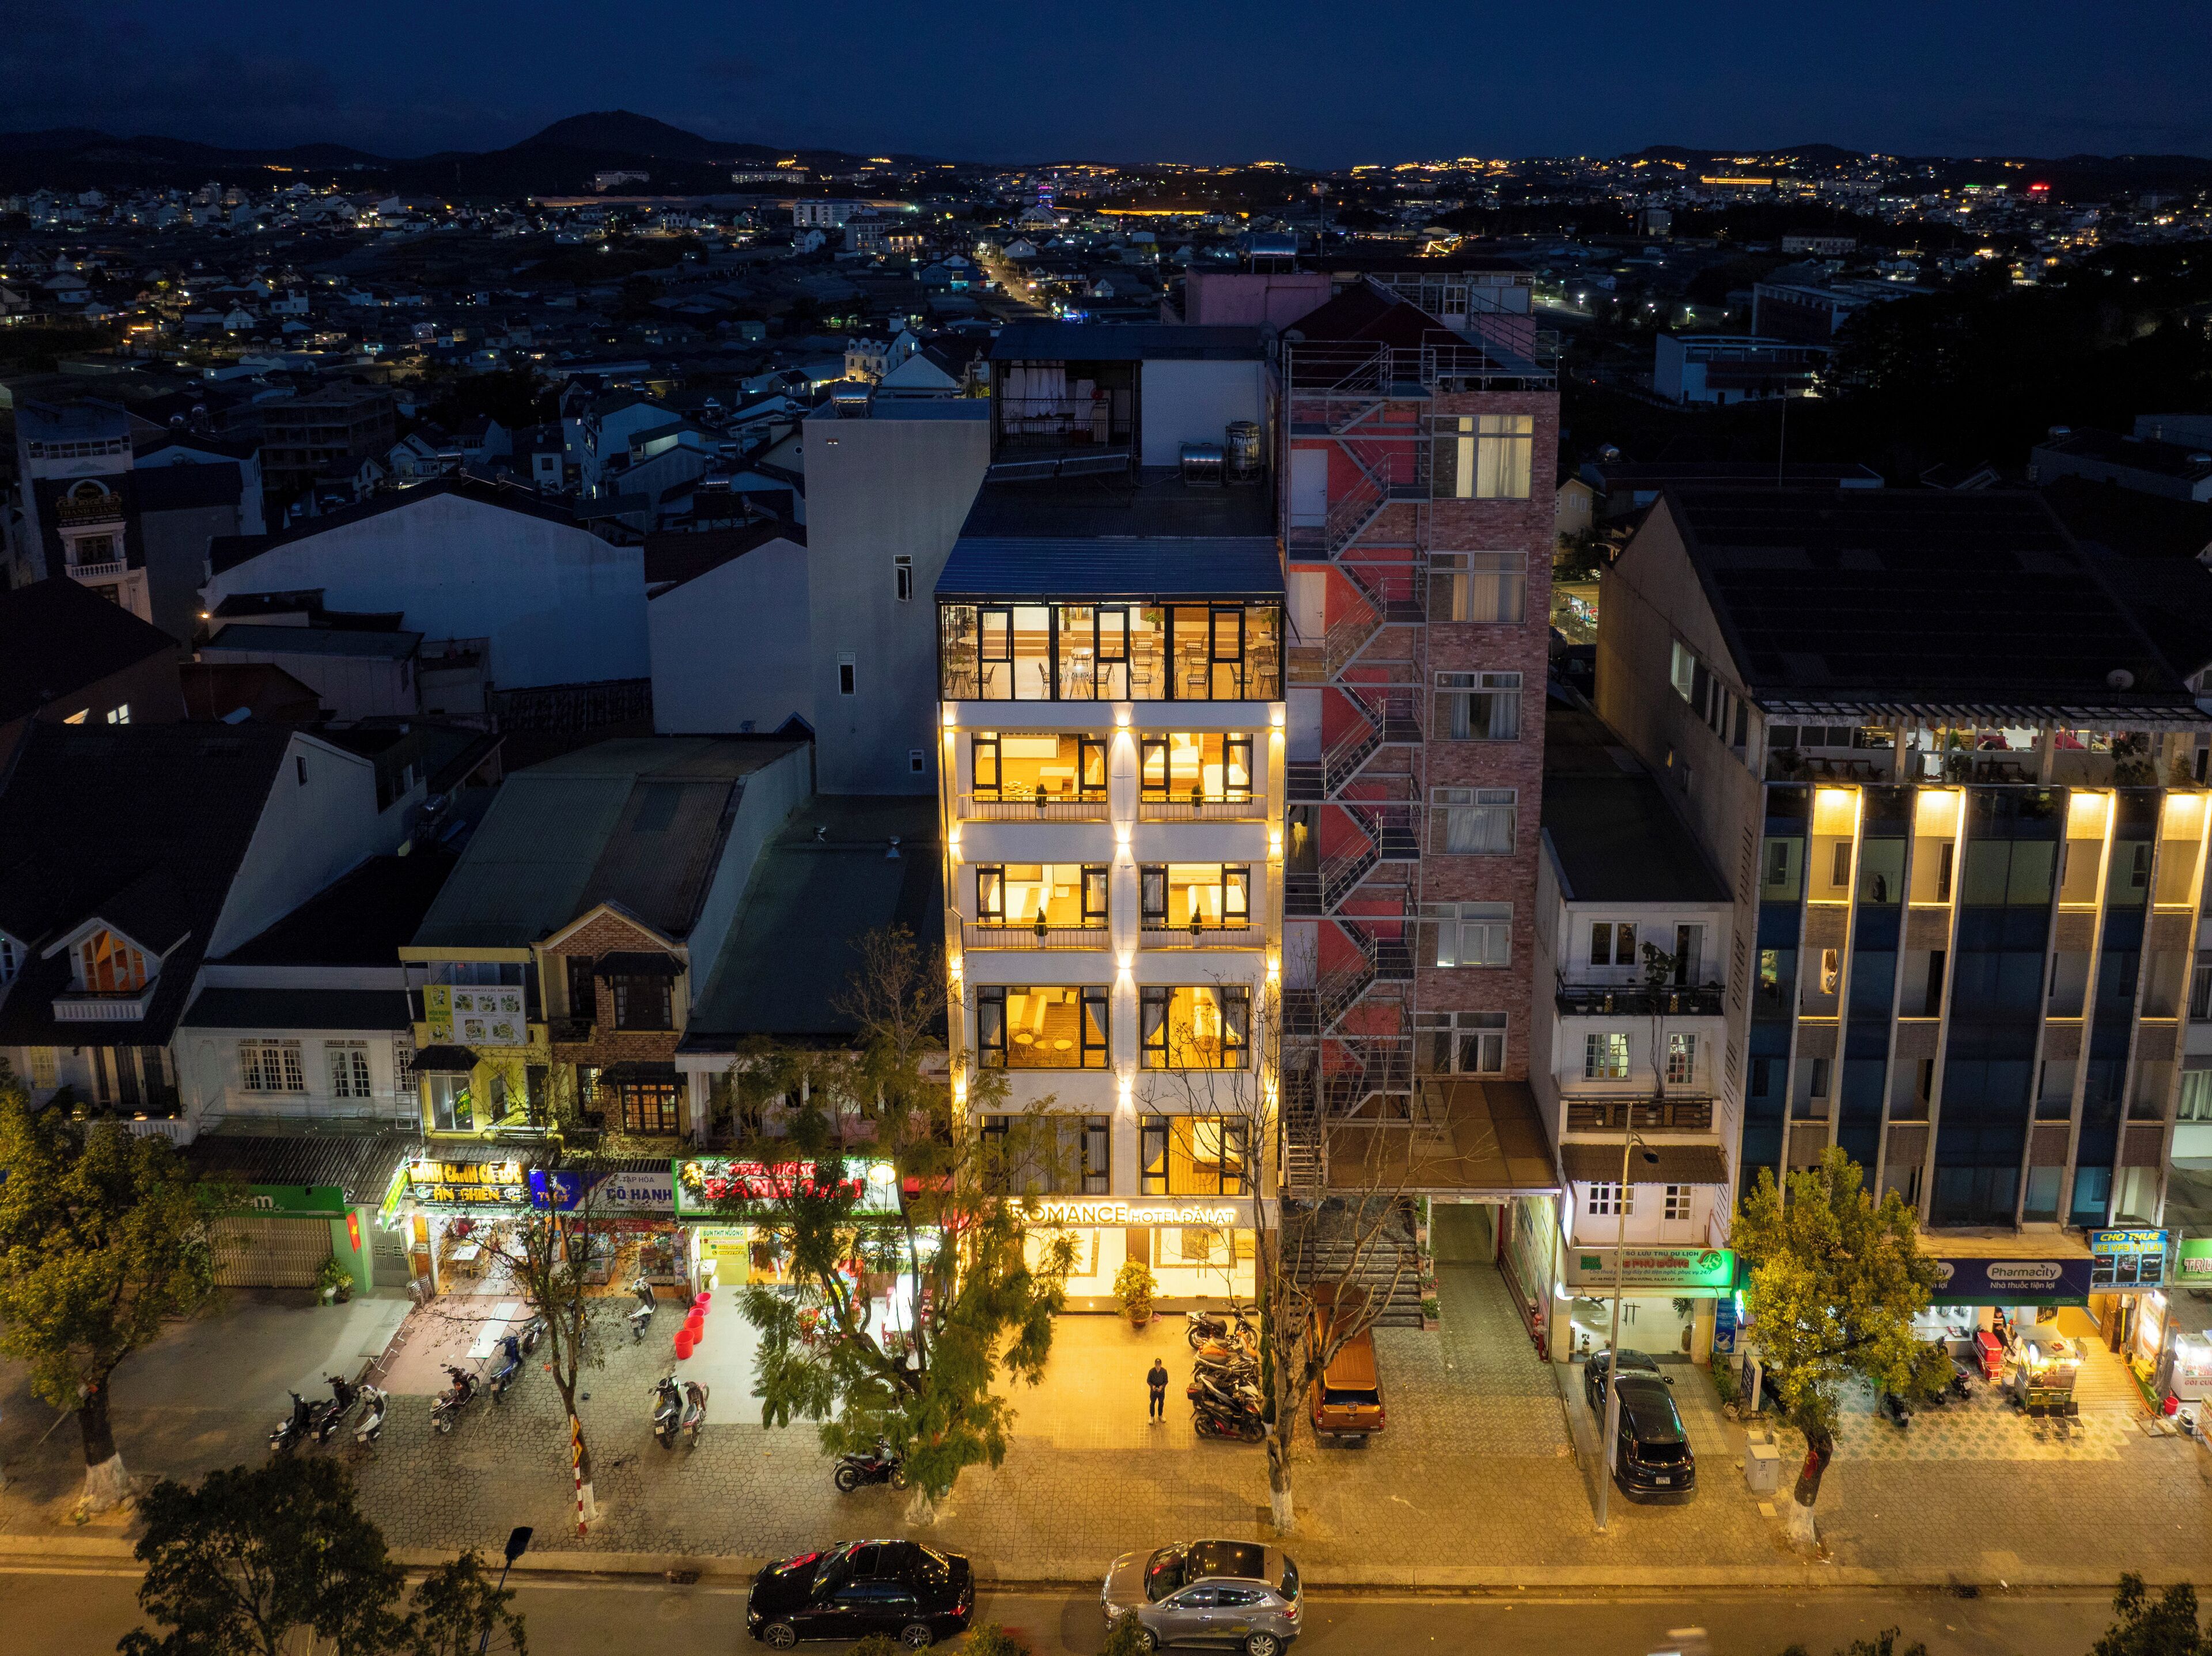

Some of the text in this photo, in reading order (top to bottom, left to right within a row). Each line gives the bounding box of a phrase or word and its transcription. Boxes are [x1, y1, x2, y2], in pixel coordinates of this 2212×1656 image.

[1132, 1212, 1179, 1222] HOTEL
[2111, 1244, 2130, 1252] VF3
[2147, 1243, 2162, 1252] LÁI
[1991, 1265, 2056, 1278] Pharmacity
